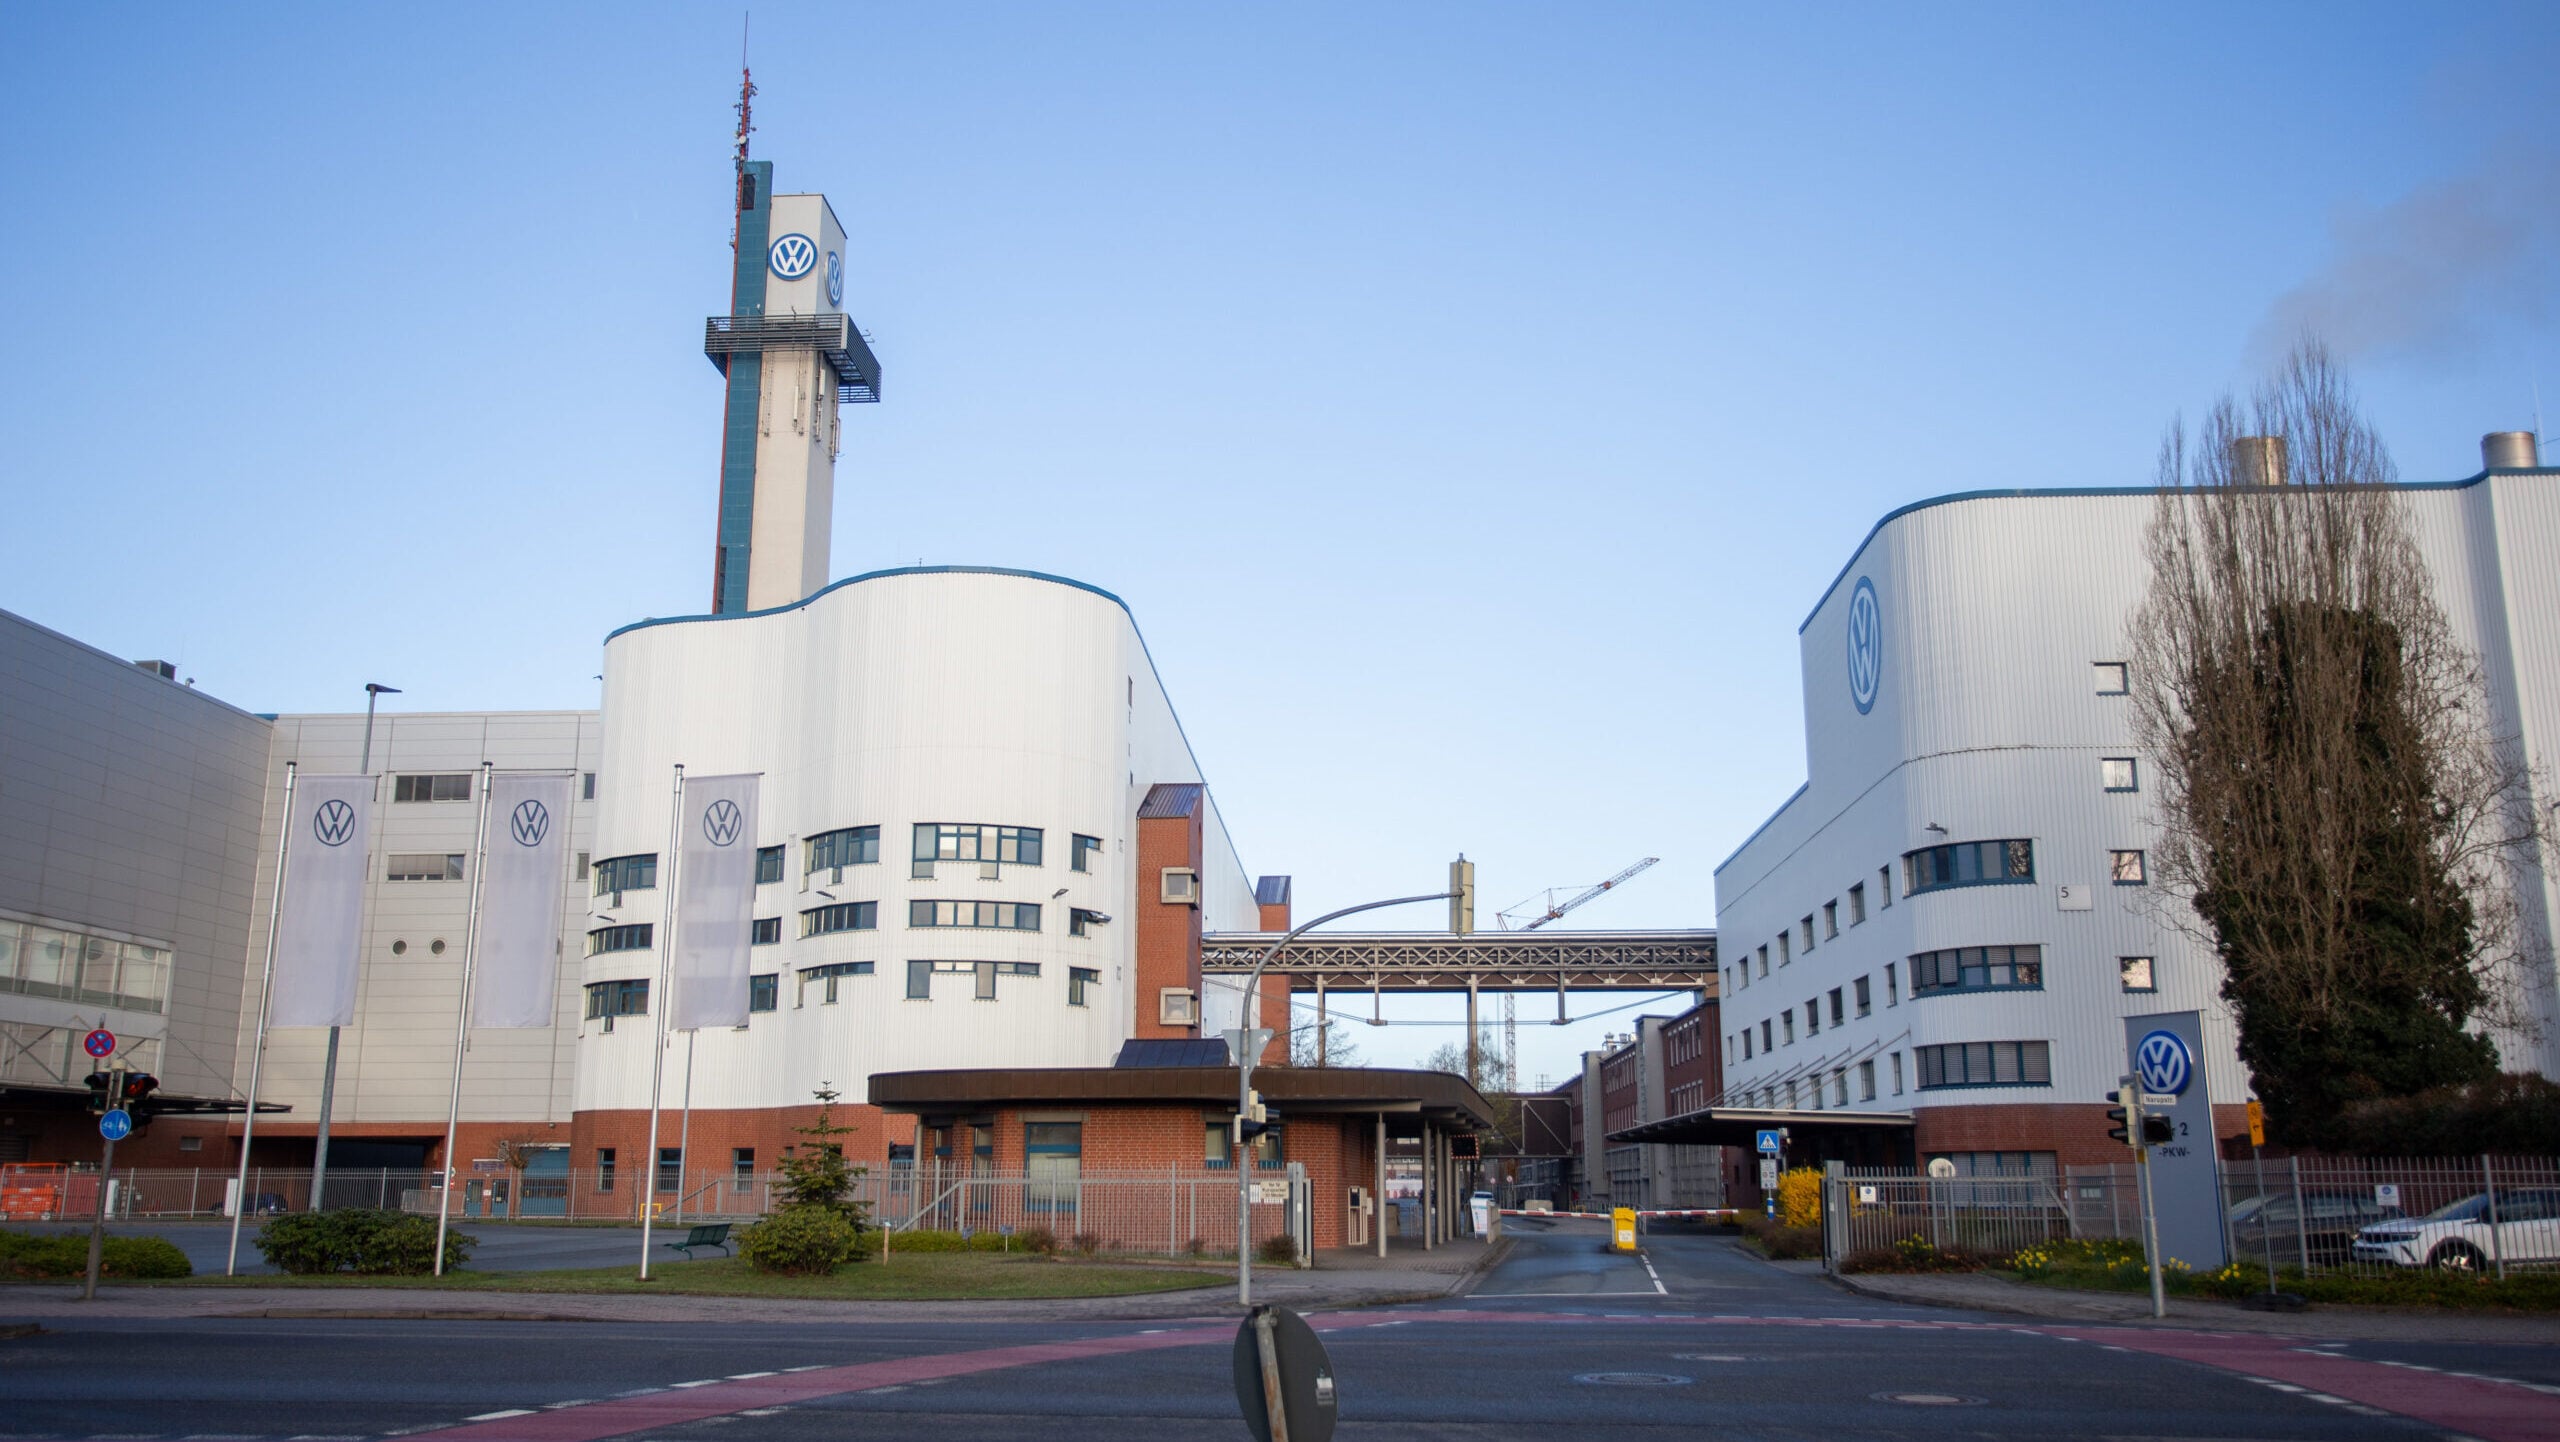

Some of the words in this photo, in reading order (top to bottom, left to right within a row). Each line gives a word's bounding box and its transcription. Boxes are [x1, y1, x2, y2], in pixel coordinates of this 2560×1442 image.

[773, 237, 813, 275] VW
[828, 254, 841, 302] VW
[1850, 587, 1878, 704] VW
[316, 800, 354, 844] VW
[513, 800, 547, 844] VW
[705, 800, 741, 844] VW
[2061, 886, 2069, 899] 5
[2139, 1036, 2184, 1092] VW
[2180, 1122, 2189, 1136] 2
